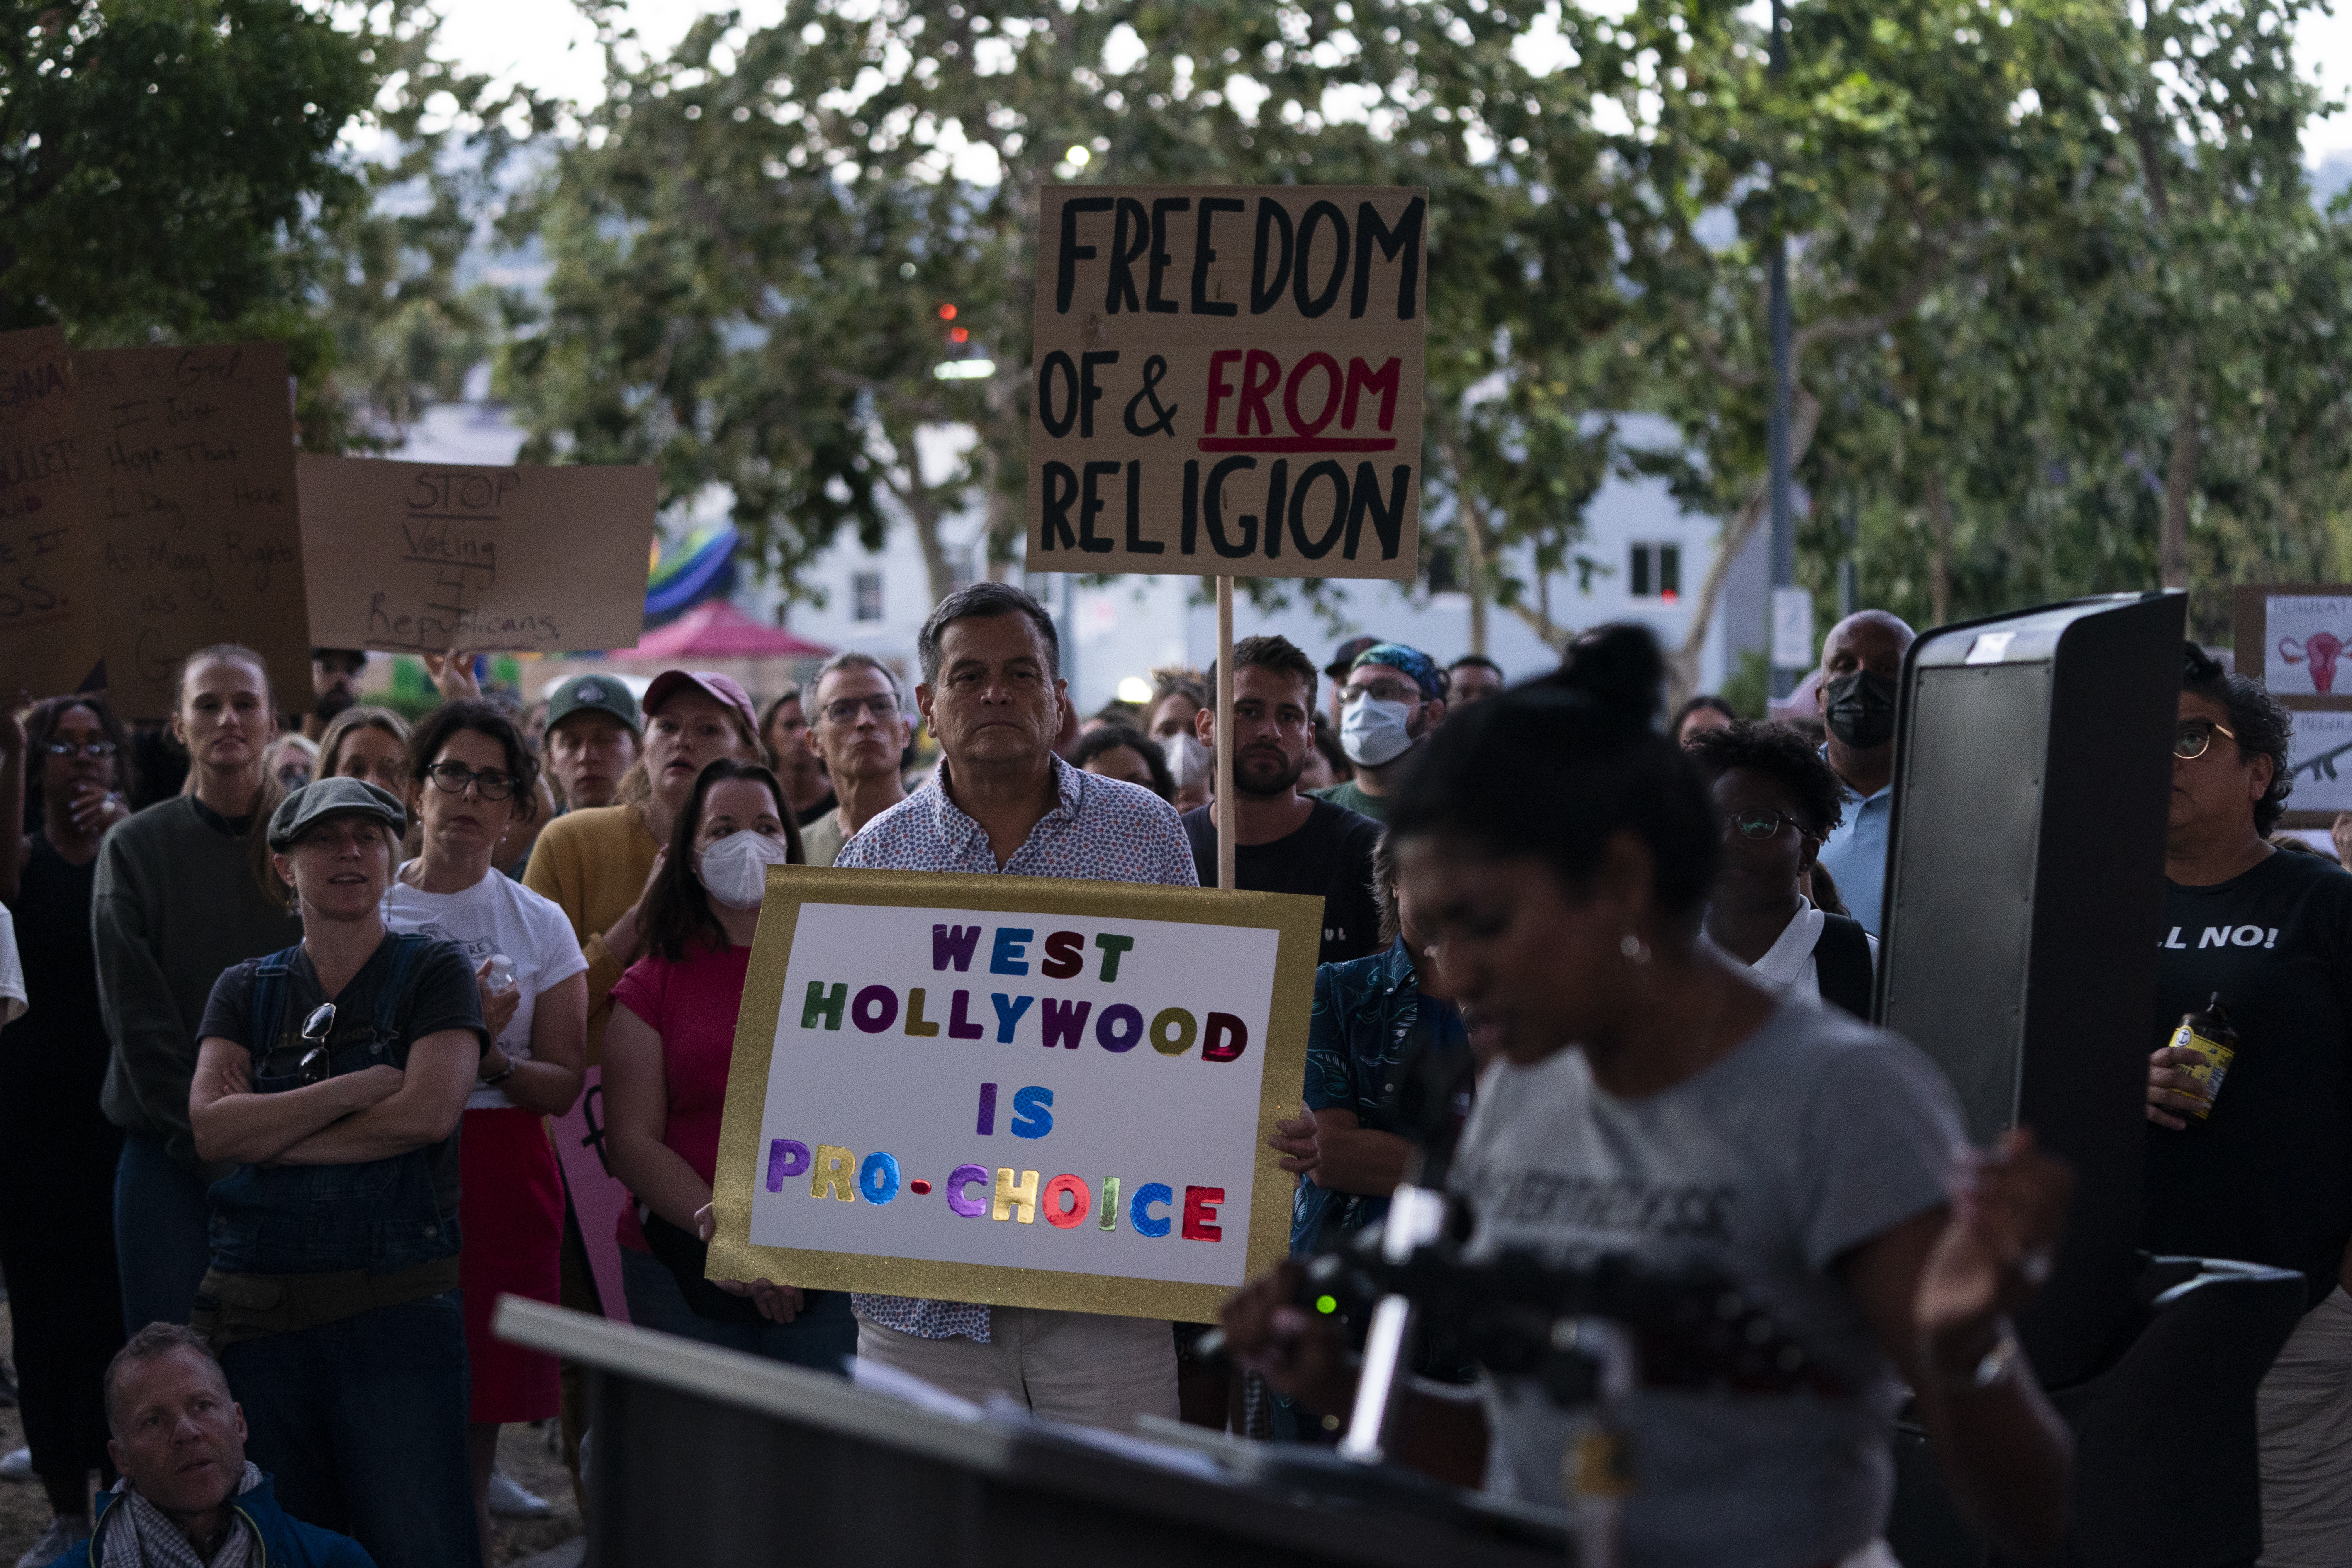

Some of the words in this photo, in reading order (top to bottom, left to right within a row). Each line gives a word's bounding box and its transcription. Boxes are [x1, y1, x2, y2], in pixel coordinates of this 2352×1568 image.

[1057, 197, 1425, 321] FREEDOM
[1039, 350, 1119, 438] OF
[1124, 355, 1178, 438] &
[1205, 349, 1402, 438] FROM
[106, 440, 165, 475] Hope
[172, 441, 241, 465] That
[407, 470, 521, 509] STOP
[1041, 456, 1410, 560] RELIGION
[148, 540, 213, 601] Many
[402, 521, 496, 591] Voting
[932, 924, 1134, 982] WEST
[2157, 925, 2187, 949] L
[2197, 924, 2279, 949] NO!
[801, 981, 1248, 1062] HOLLYWOOD
[977, 1083, 1054, 1139] IS
[765, 1139, 1225, 1242] PRO-CHOICE
